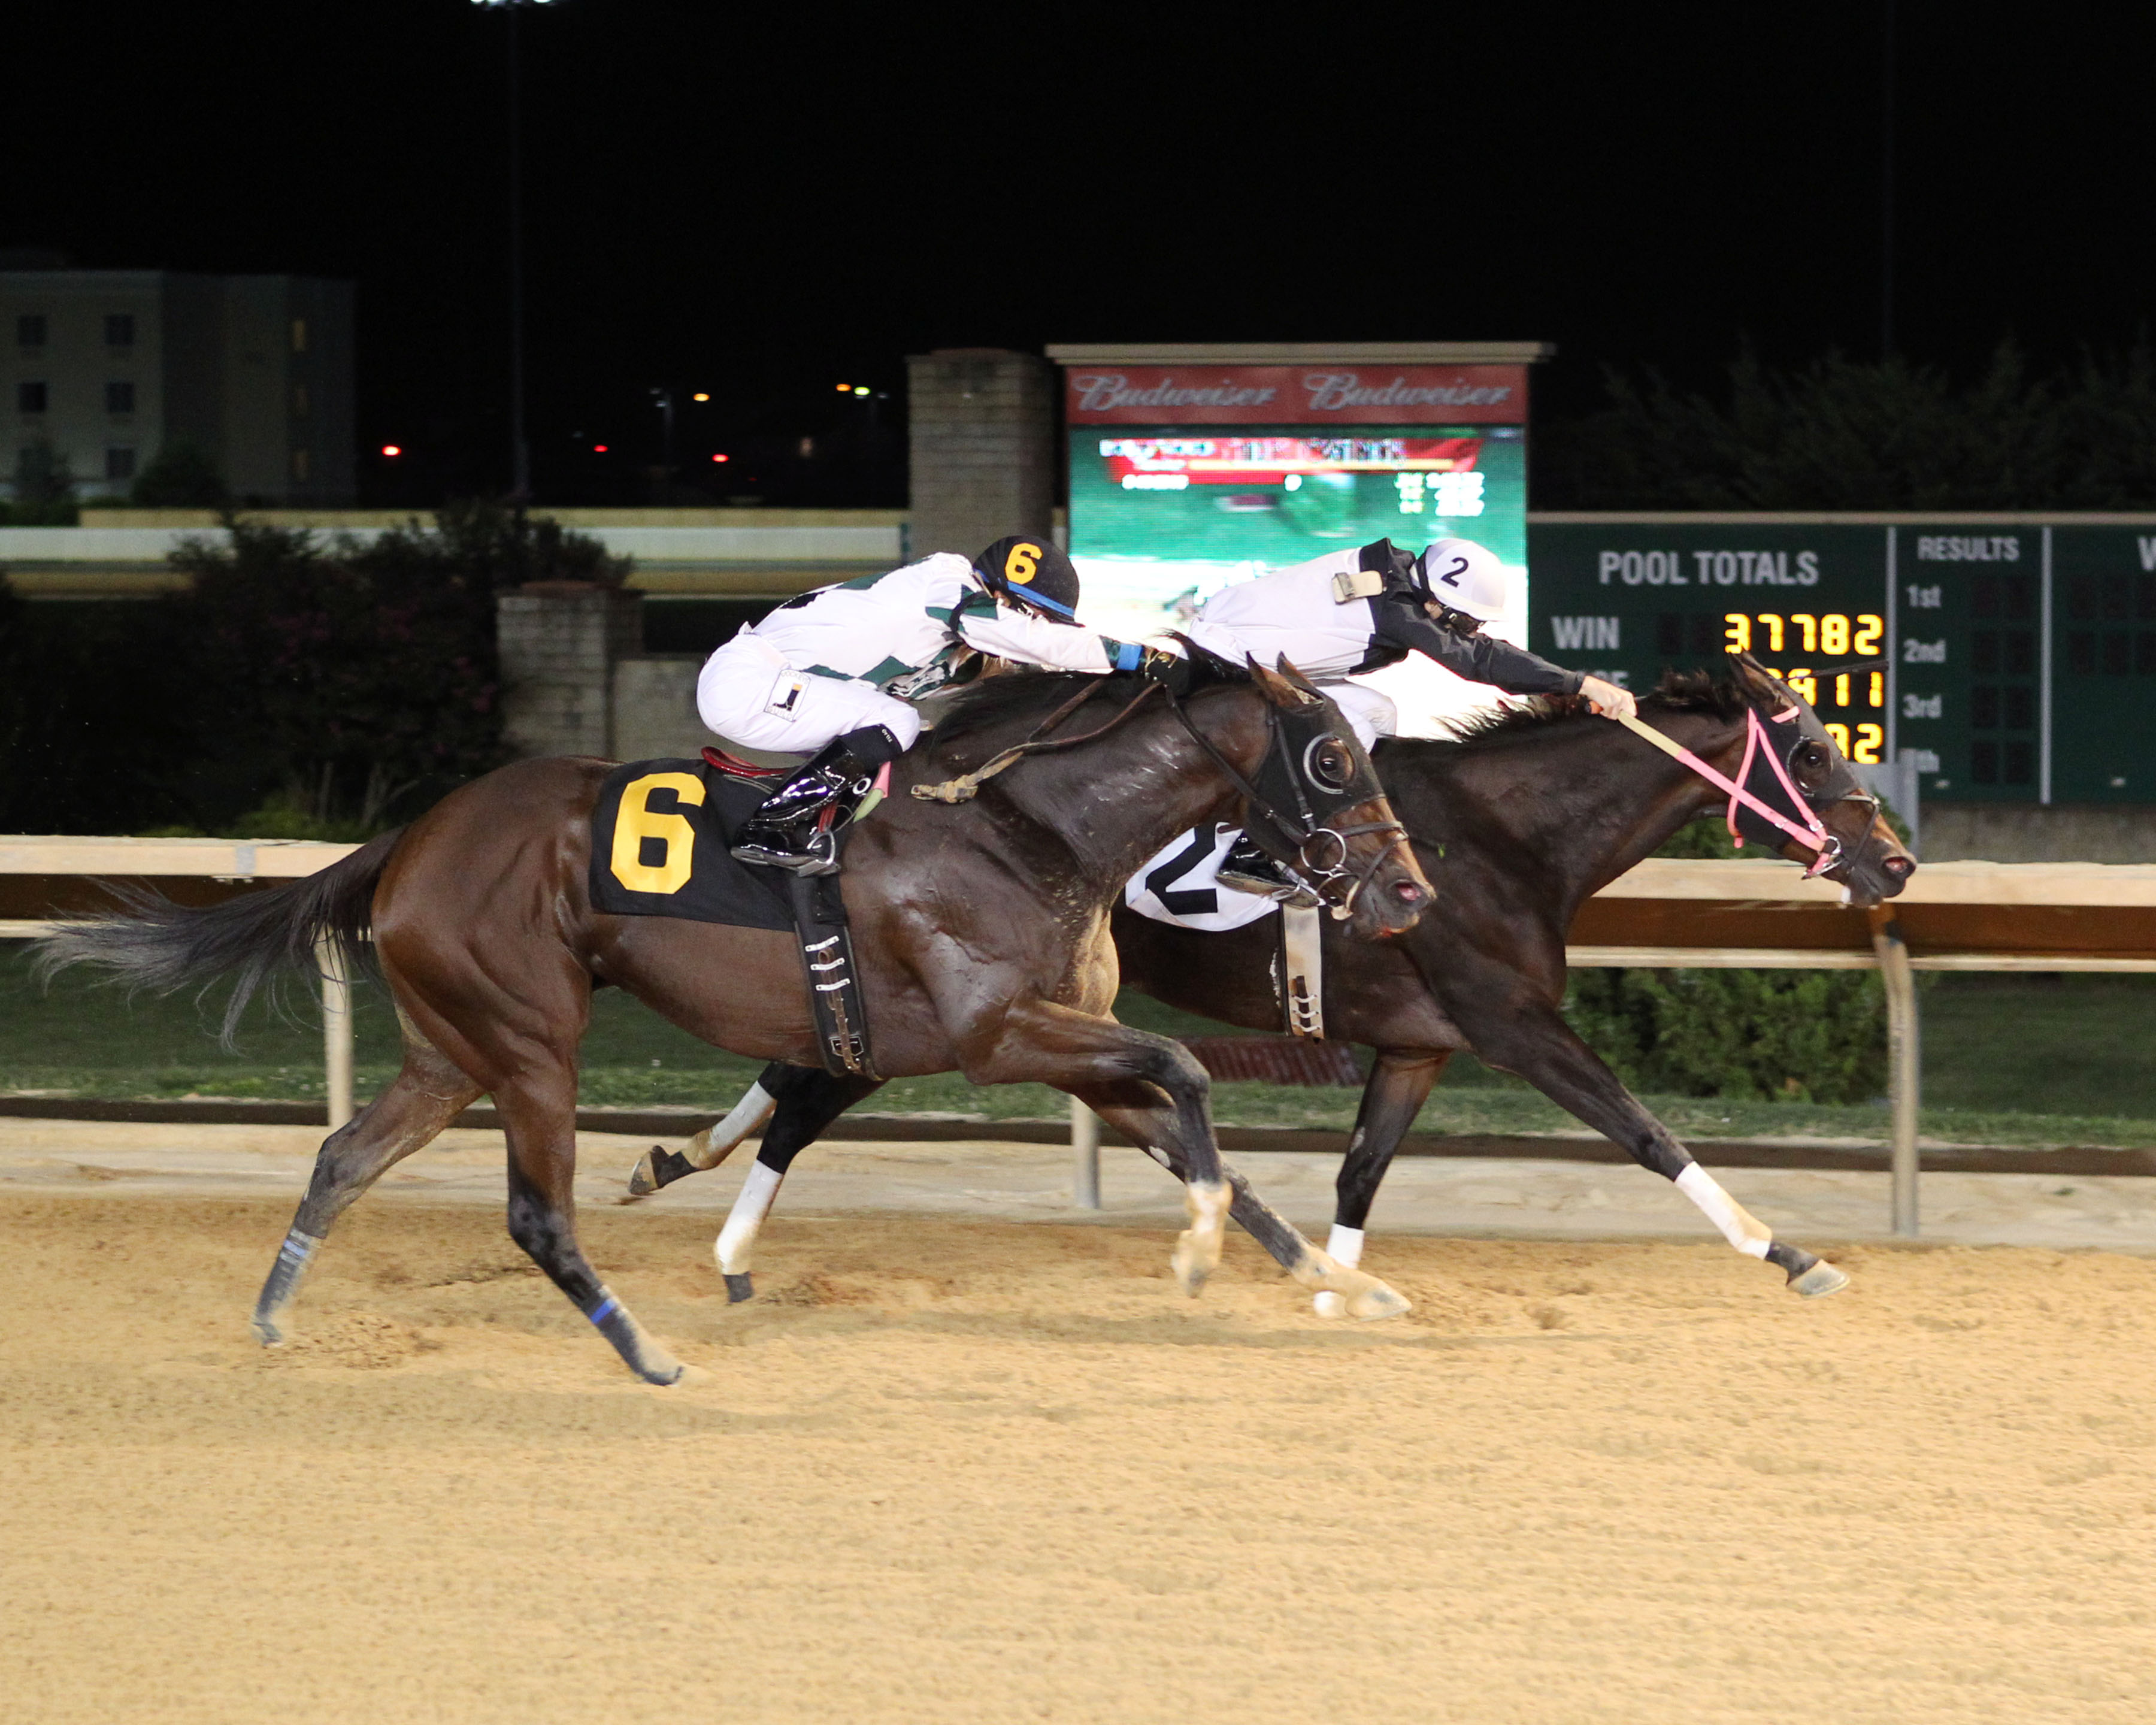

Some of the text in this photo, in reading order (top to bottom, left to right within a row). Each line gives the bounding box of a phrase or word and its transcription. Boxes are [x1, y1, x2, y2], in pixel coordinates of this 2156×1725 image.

[1071, 375, 1277, 411] Budweiser
[1303, 373, 1512, 411] Budweiser
[1005, 542, 1043, 585] 6
[1918, 536, 2020, 561] RESULTS
[1440, 556, 1469, 588] 2
[1598, 550, 1819, 586] POOL TOTALS
[1907, 584, 1942, 608] 1st
[1551, 616, 1619, 650] WIN
[1724, 613, 1884, 655] 37782
[1903, 638, 1946, 663] 2nd
[1764, 667, 1884, 707] 911
[1903, 693, 1942, 719] 3rd
[610, 772, 706, 895] 6
[1145, 822, 1218, 916] 2
